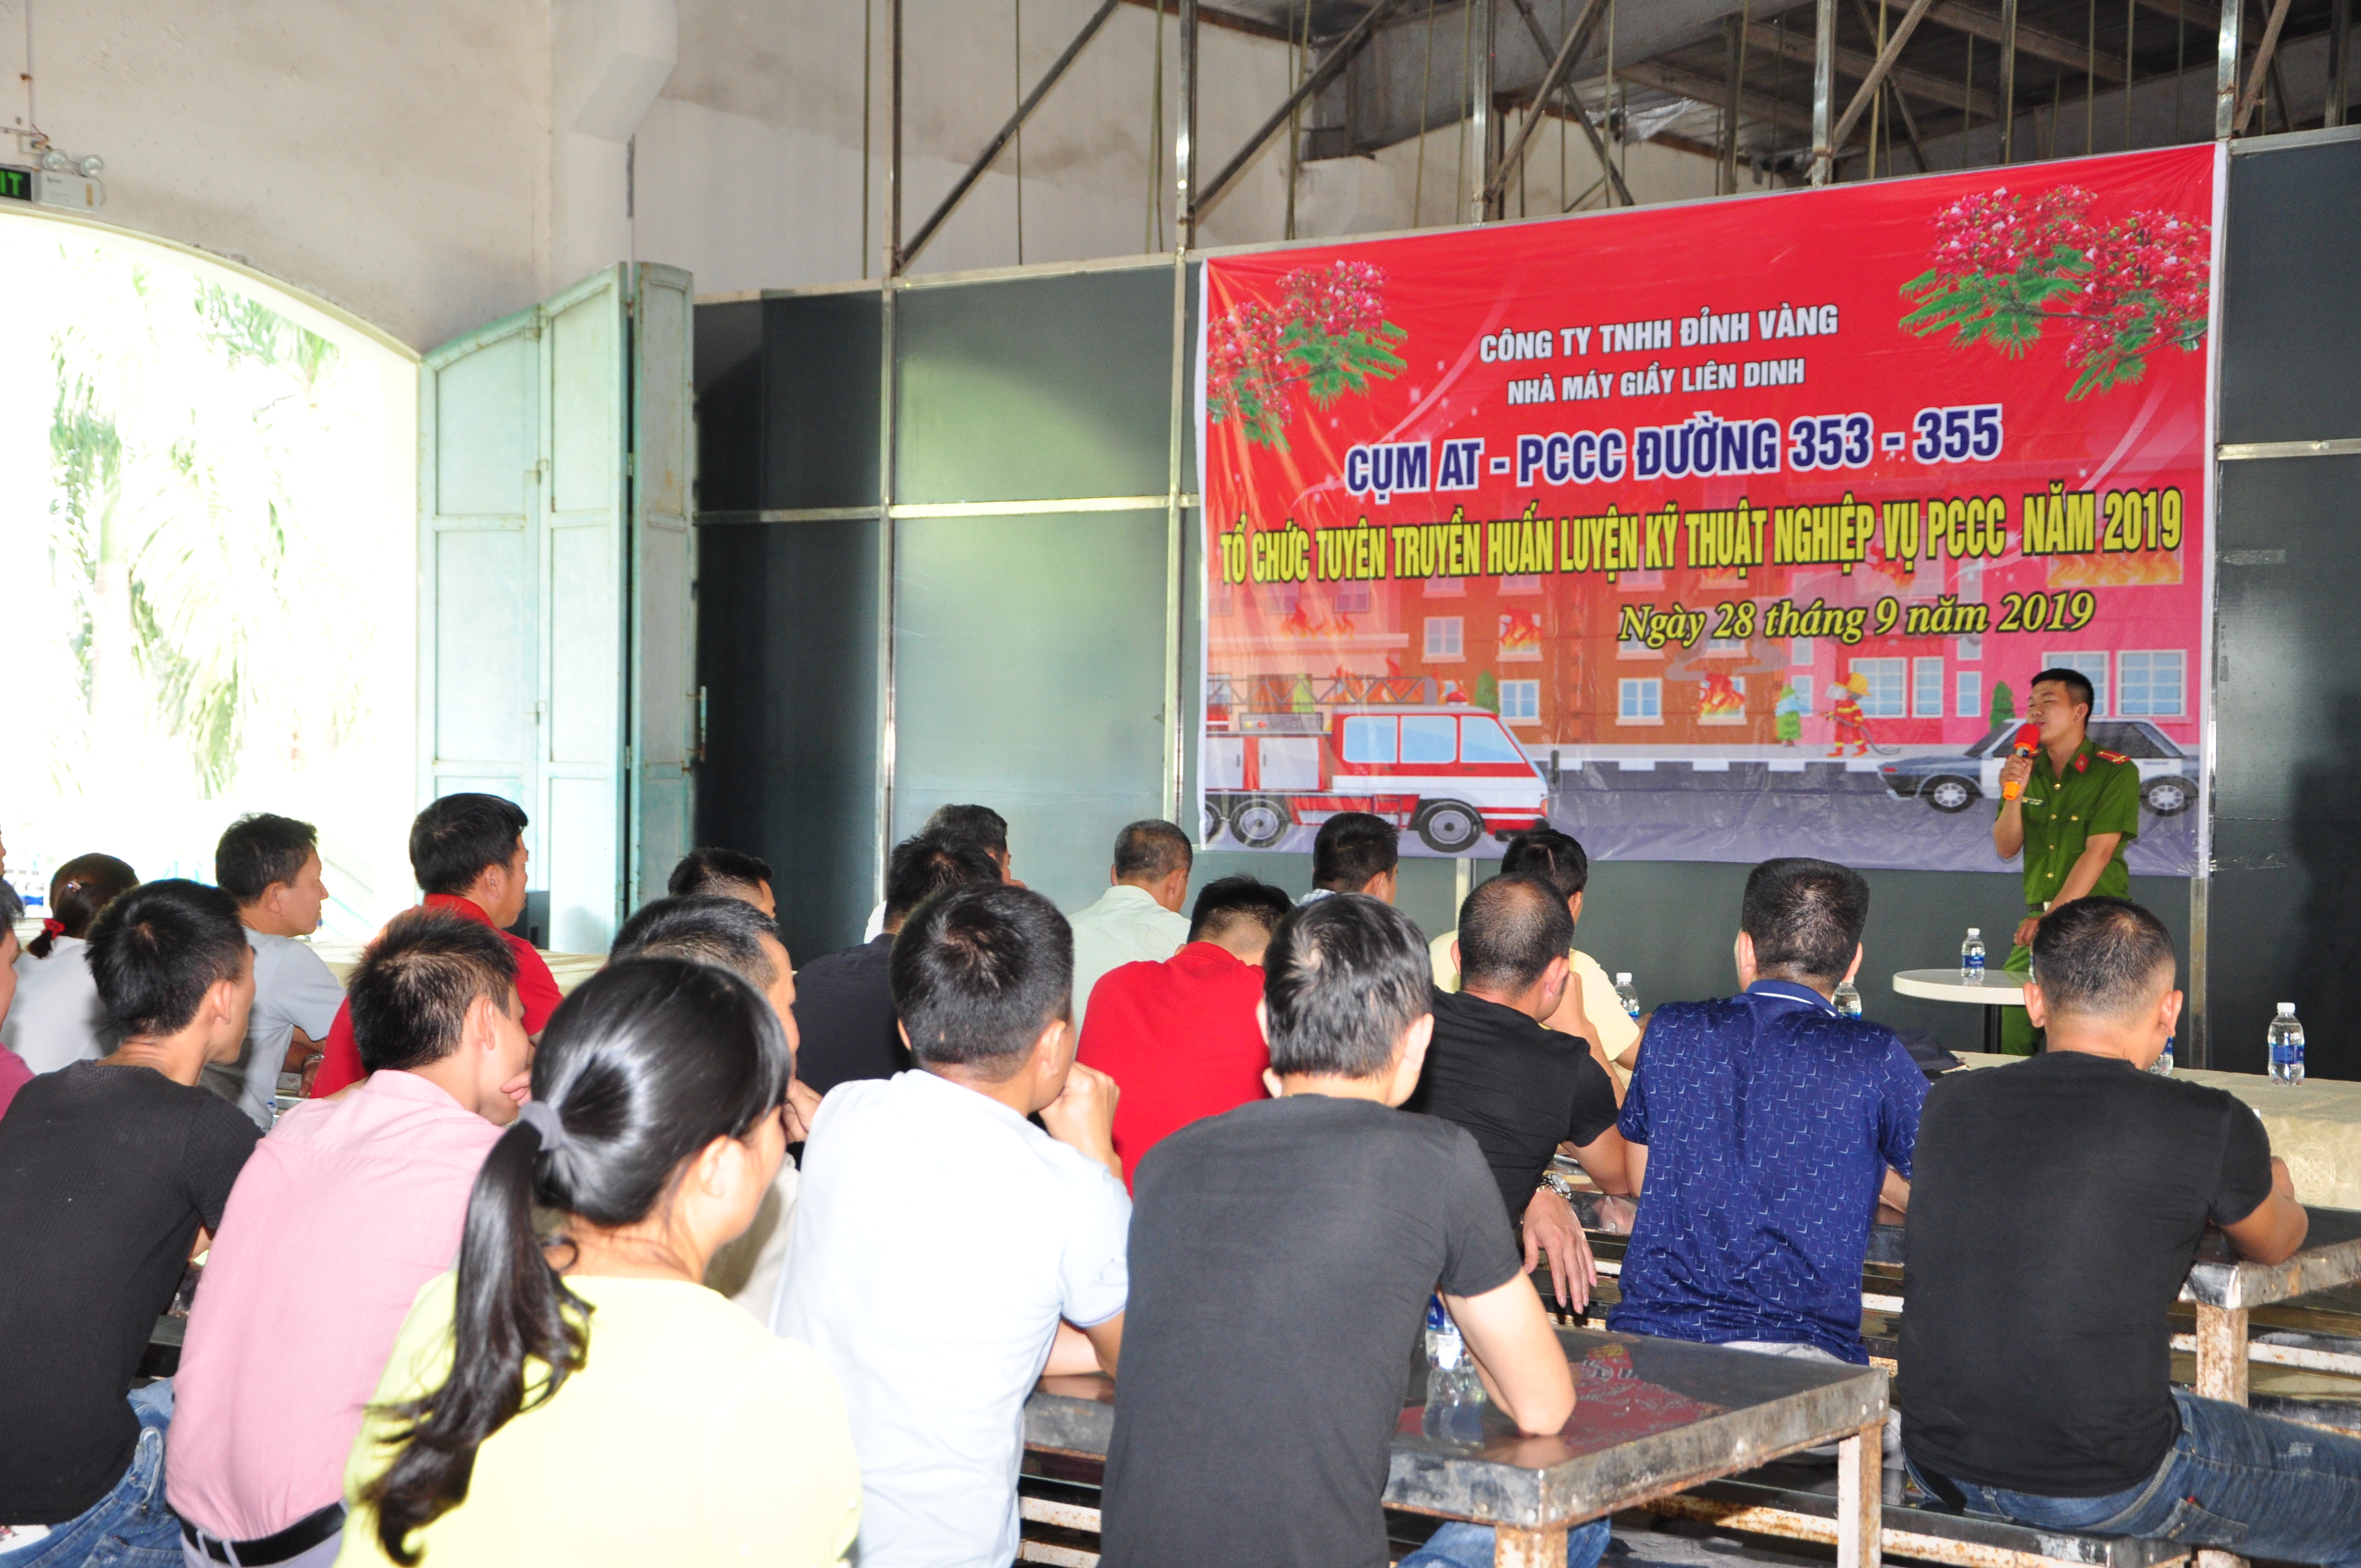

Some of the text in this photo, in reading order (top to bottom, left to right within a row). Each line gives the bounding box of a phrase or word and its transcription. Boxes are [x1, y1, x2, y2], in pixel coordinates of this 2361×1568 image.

[1481, 302, 1838, 362] CÔNG TY TNHH ĐỈNH VÀNG
[1507, 358, 1805, 405] NHÀ MÁY GIẦY LIÊN DINH
[1345, 404, 2003, 504] CỤM AT - PCCC ĐƯỜNG 353 - 355
[1220, 479, 2183, 585] TỔ CHỨC TUYÊN TRUYỀN HUẤN LUYỆN KỸ THUẬT NGHIỆP VỤ PCCC NĂM 2019
[1617, 590, 2097, 649] Ngày 28 tháng 9 năm 2019
